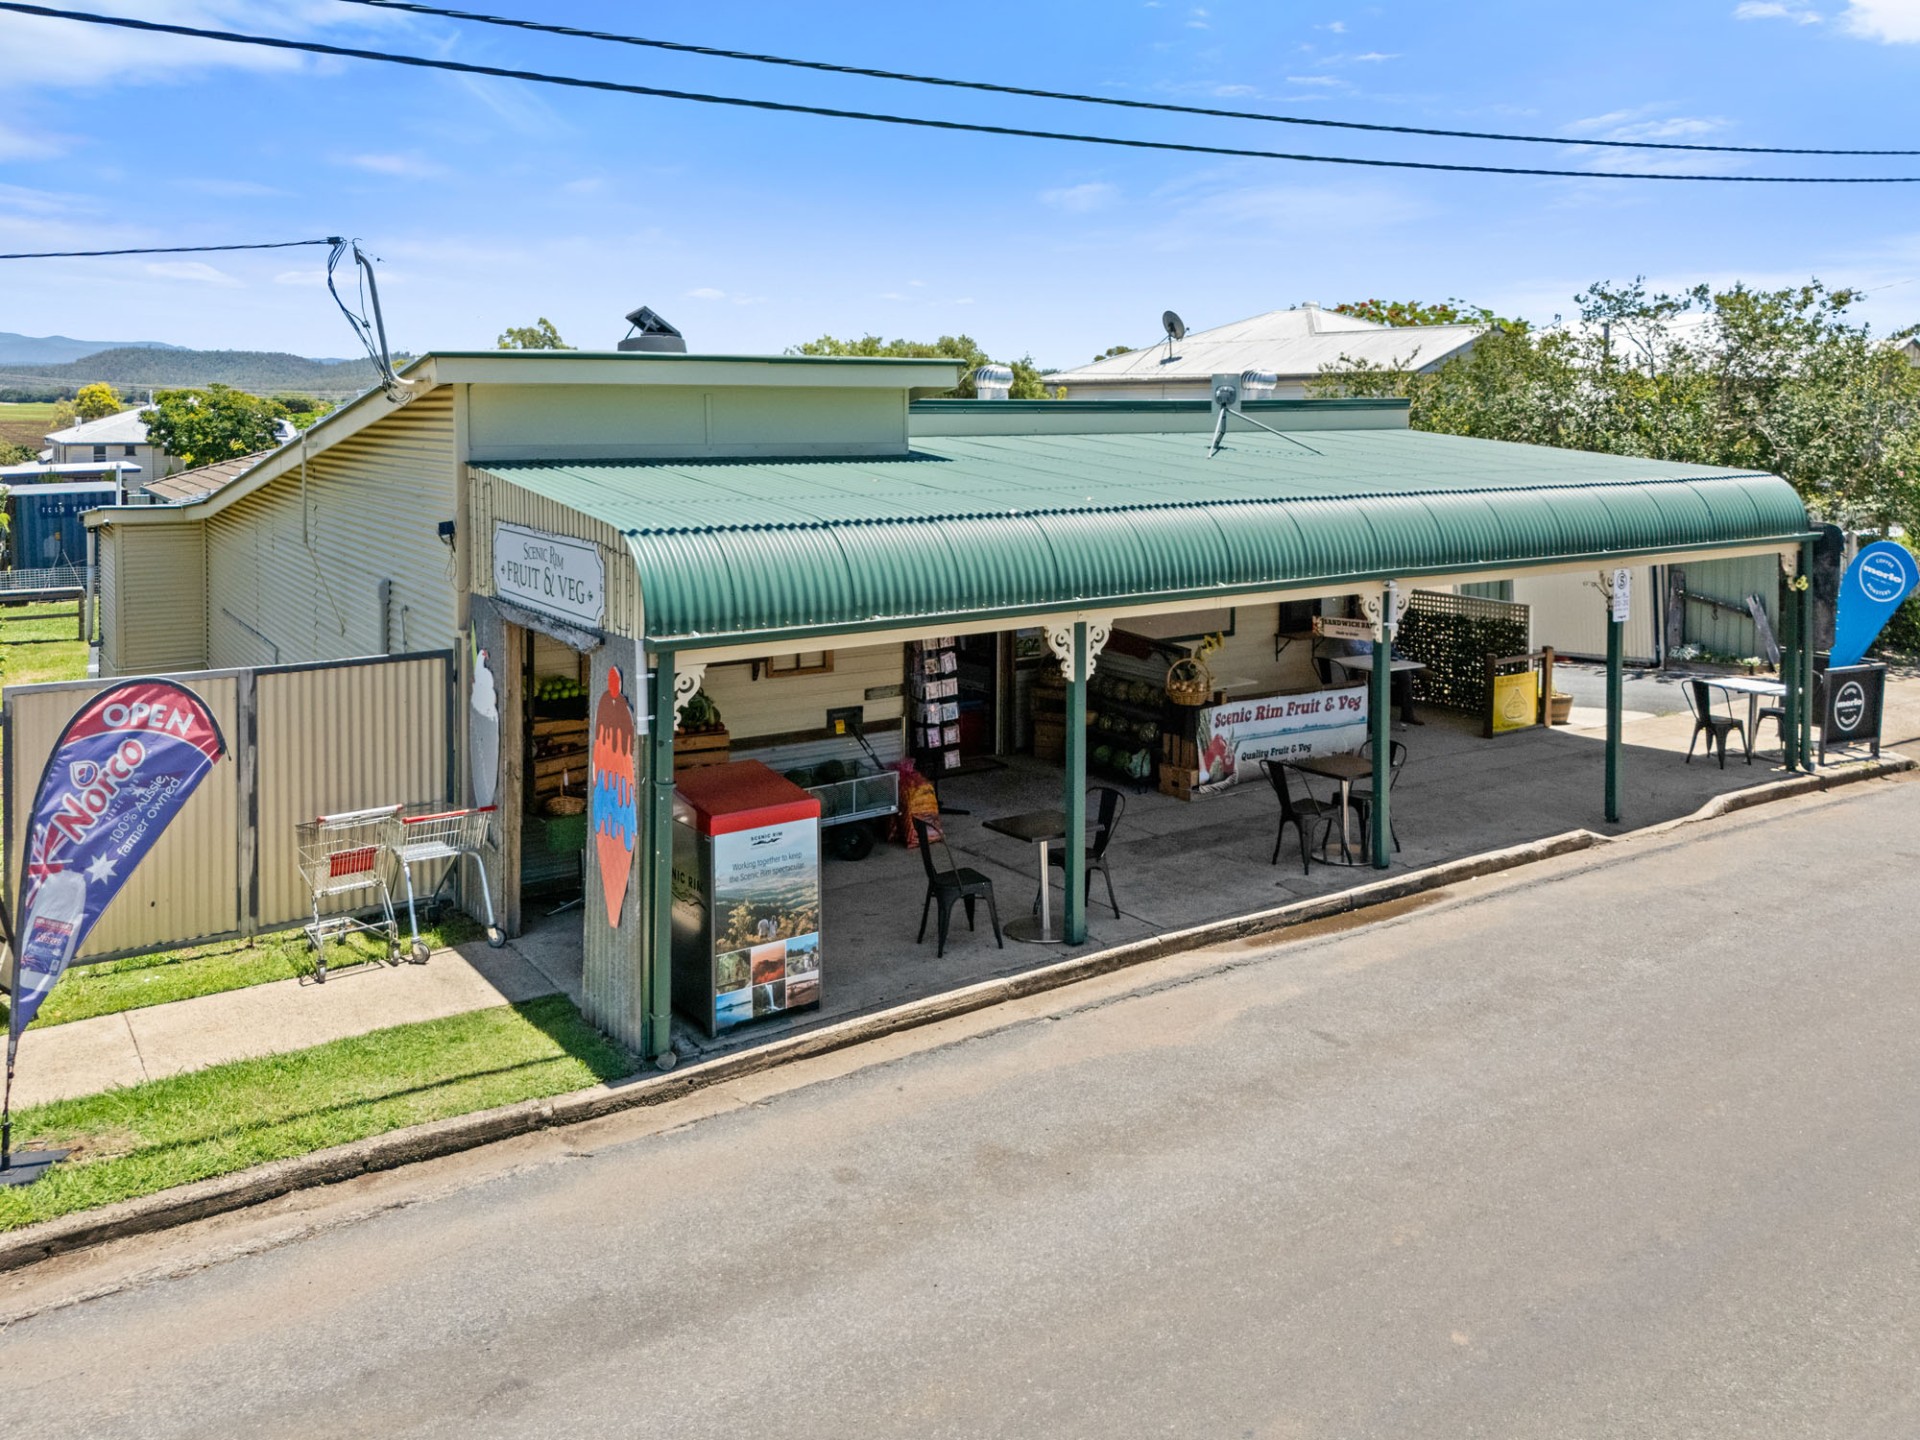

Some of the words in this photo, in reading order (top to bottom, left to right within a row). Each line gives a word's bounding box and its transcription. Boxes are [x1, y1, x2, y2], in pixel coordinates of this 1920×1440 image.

[523, 542, 548, 562] SCENIC
[549, 546, 564, 570] RIM
[507, 561, 540, 589] FRUIT
[544, 566, 555, 598] &
[558, 575, 585, 604] VEG
[103, 702, 195, 736] OPEN
[1214, 707, 1252, 728] Scenic
[1254, 704, 1284, 721] Rim
[1286, 698, 1321, 716] Fruit
[1324, 697, 1335, 711] &
[1338, 695, 1362, 711] Veg
[1241, 749, 1269, 761] Quality
[1270, 746, 1290, 756] Fruit
[50, 739, 145, 844] Norco
[109, 812, 137, 843] 100%
[134, 775, 170, 812] Aussie,
[117, 818, 149, 857] farmer
[750, 833, 771, 841] SCENIC
[732, 861, 757, 871] Working
[757, 855, 781, 867] together
